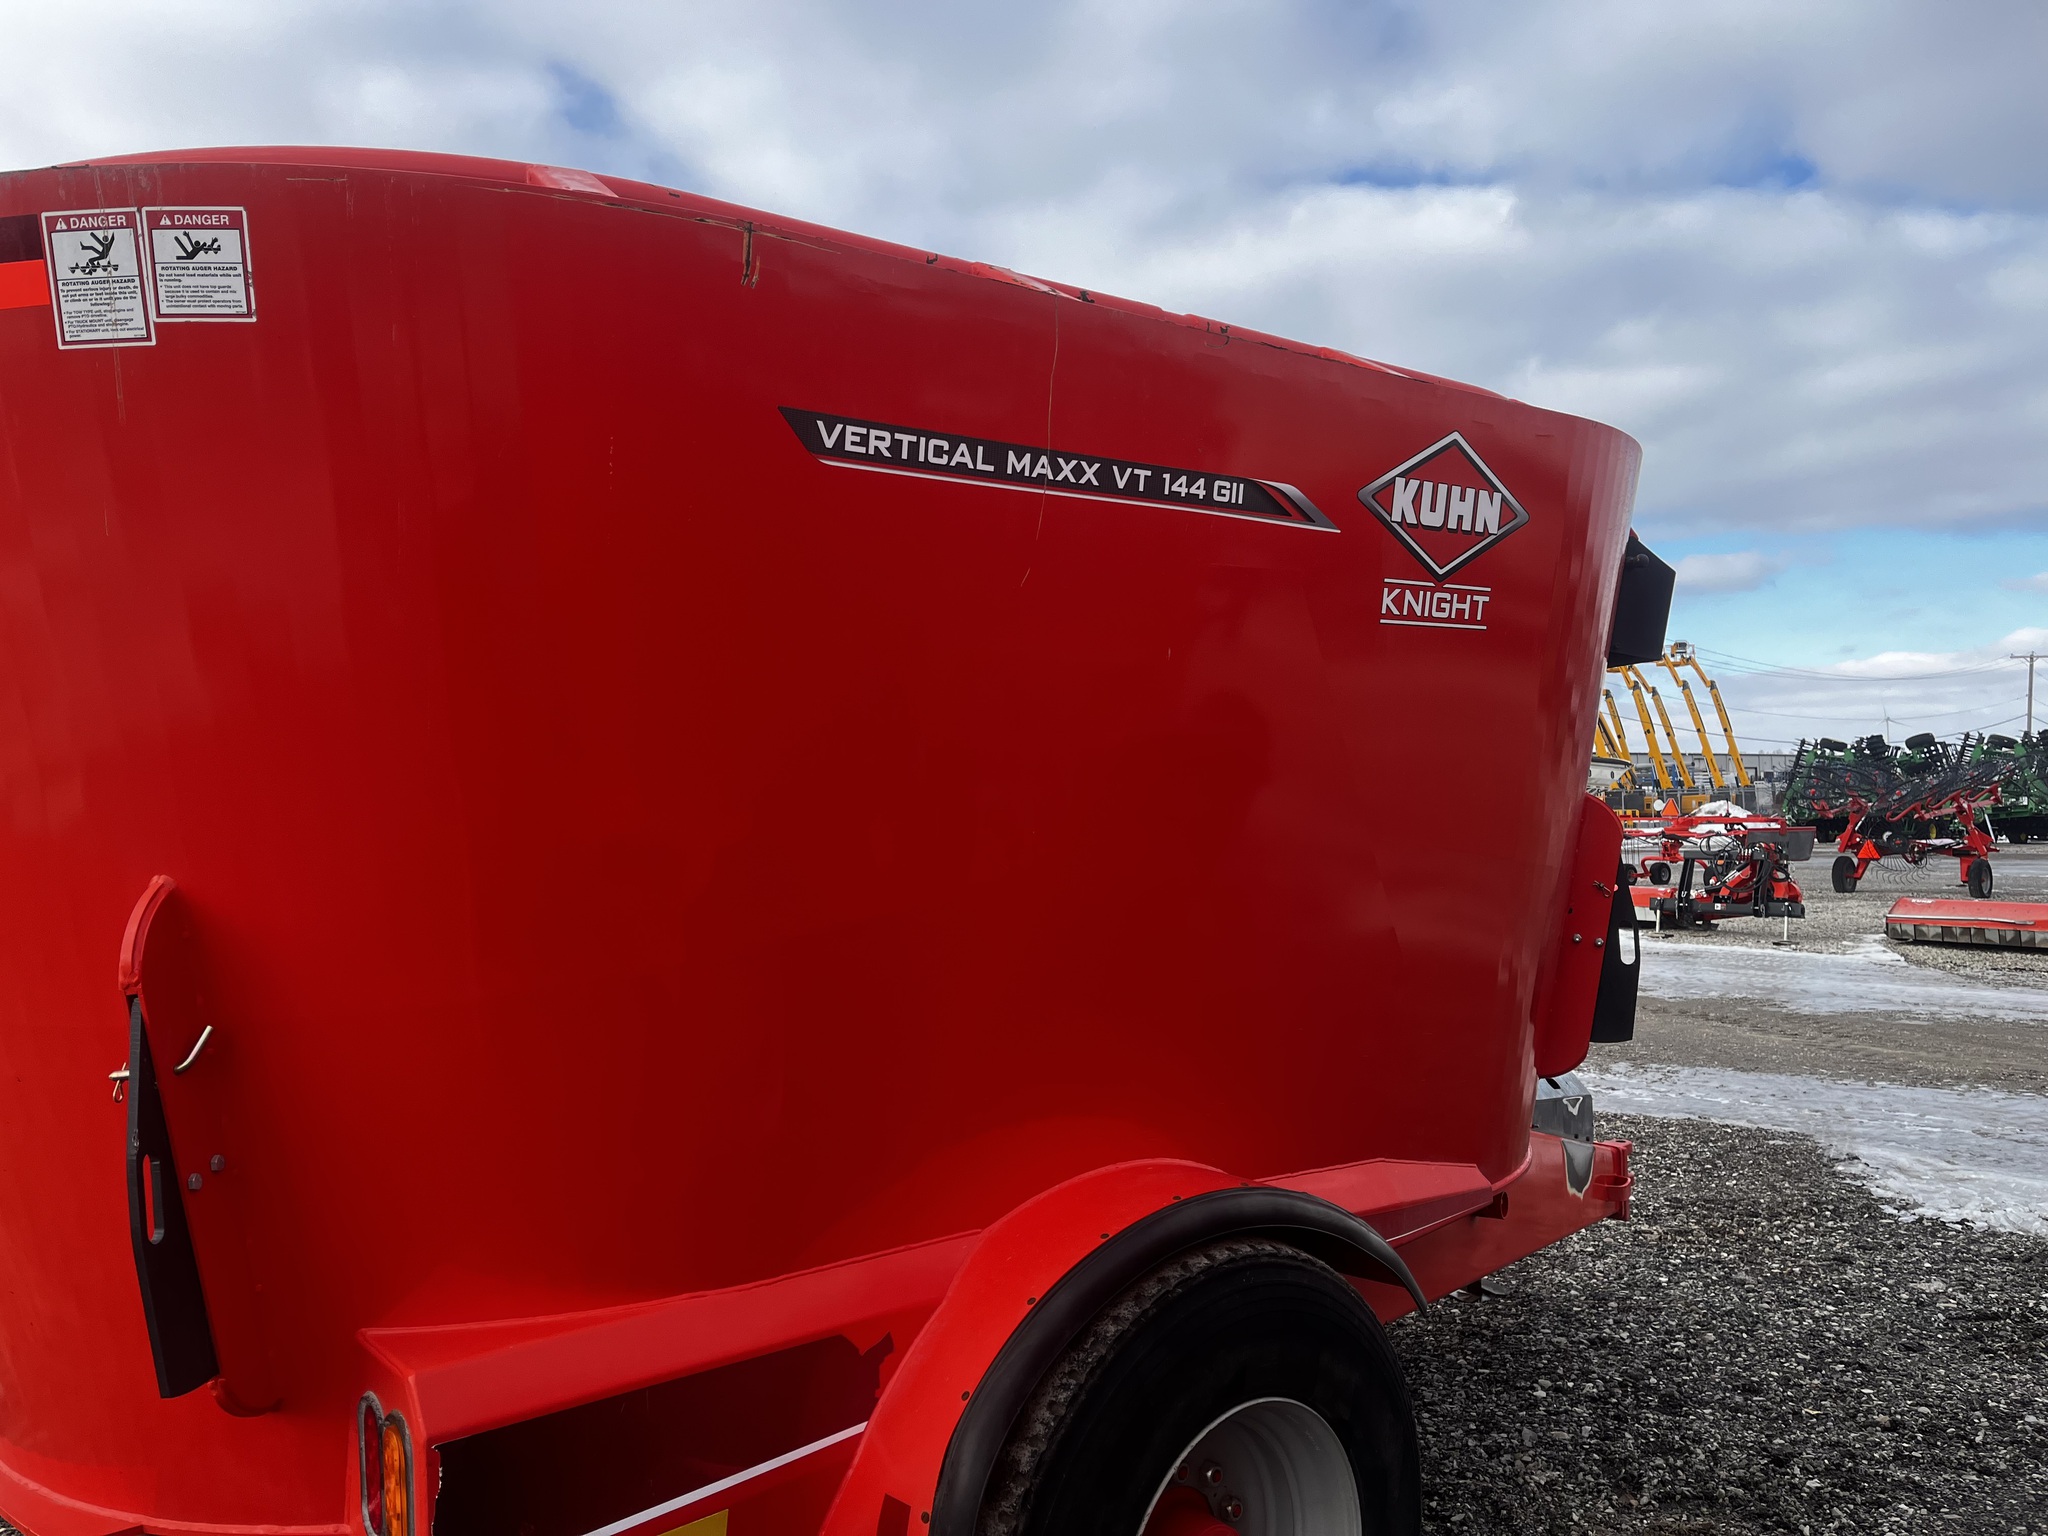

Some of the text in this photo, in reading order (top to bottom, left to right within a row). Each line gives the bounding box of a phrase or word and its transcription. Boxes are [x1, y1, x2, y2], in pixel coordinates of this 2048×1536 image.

[70, 215, 127, 229] DANGER
[174, 214, 229, 226] DANGER
[816, 420, 1244, 504] VERTICAL MAXX VT 144 GII
[1390, 476, 1502, 535] KUHN
[1381, 587, 1490, 621] KNIGHT
